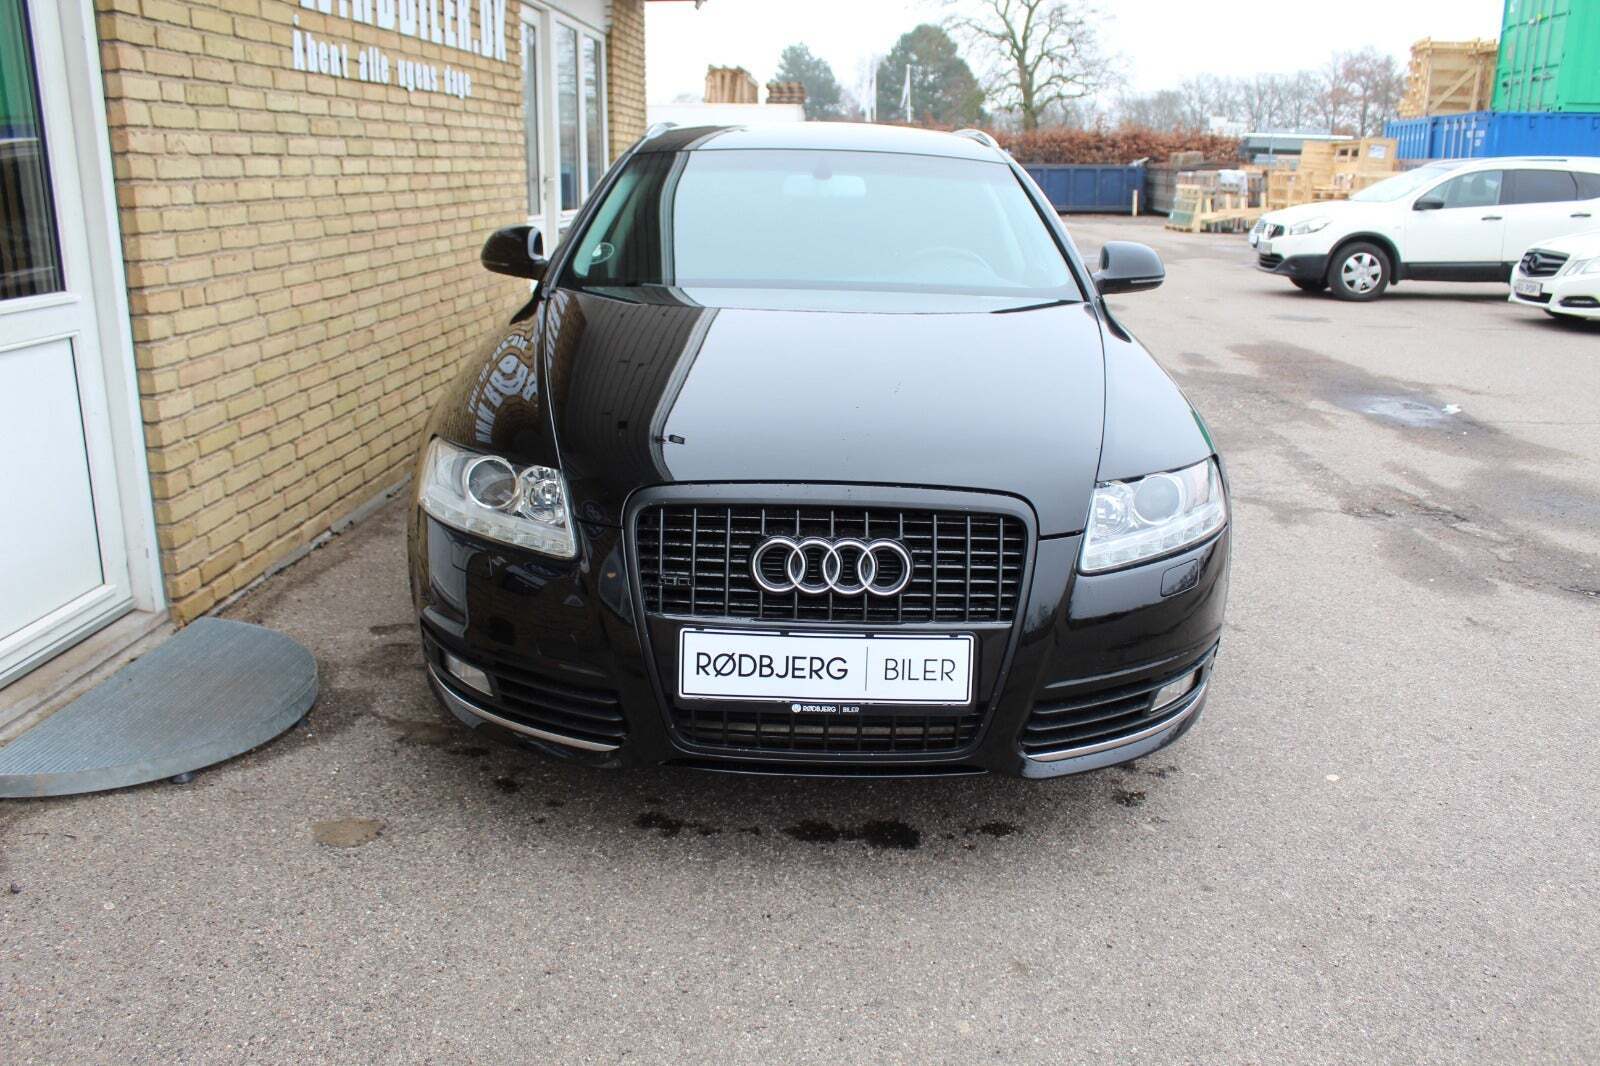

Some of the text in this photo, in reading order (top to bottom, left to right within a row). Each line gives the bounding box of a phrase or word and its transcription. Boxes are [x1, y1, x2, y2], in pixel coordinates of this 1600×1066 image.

[293, 14, 349, 78] Åbent
[359, 46, 389, 84] alle
[397, 59, 438, 92] ugens
[695, 651, 956, 682] RØDBJERG BILER
[802, 704, 837, 713] RØDBJERG
